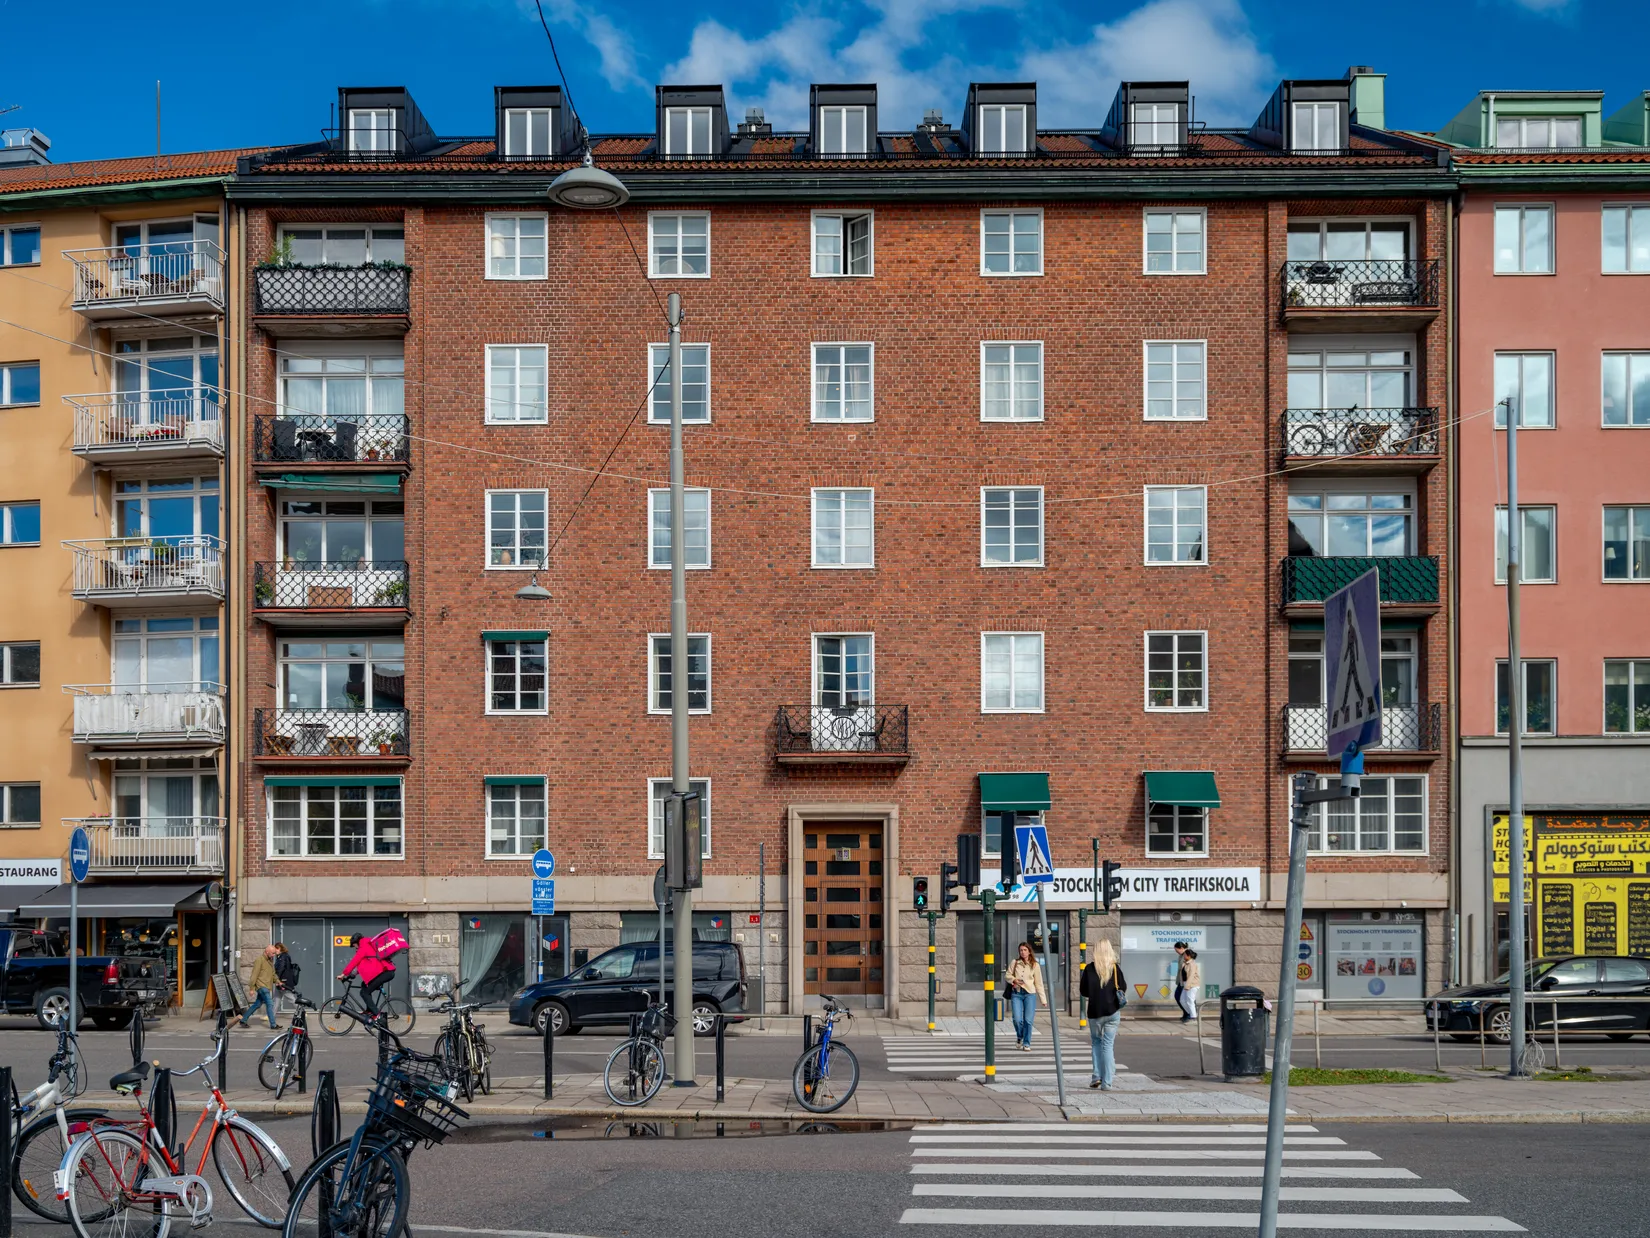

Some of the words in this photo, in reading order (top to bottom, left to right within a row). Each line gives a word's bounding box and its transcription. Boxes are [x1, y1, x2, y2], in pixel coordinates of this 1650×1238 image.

[1133, 877, 1159, 892] CITY
[1164, 877, 1250, 892] TRAFIKSKOLA
[1586, 925, 1606, 933] Digital
[1298, 968, 1310, 976] 30
